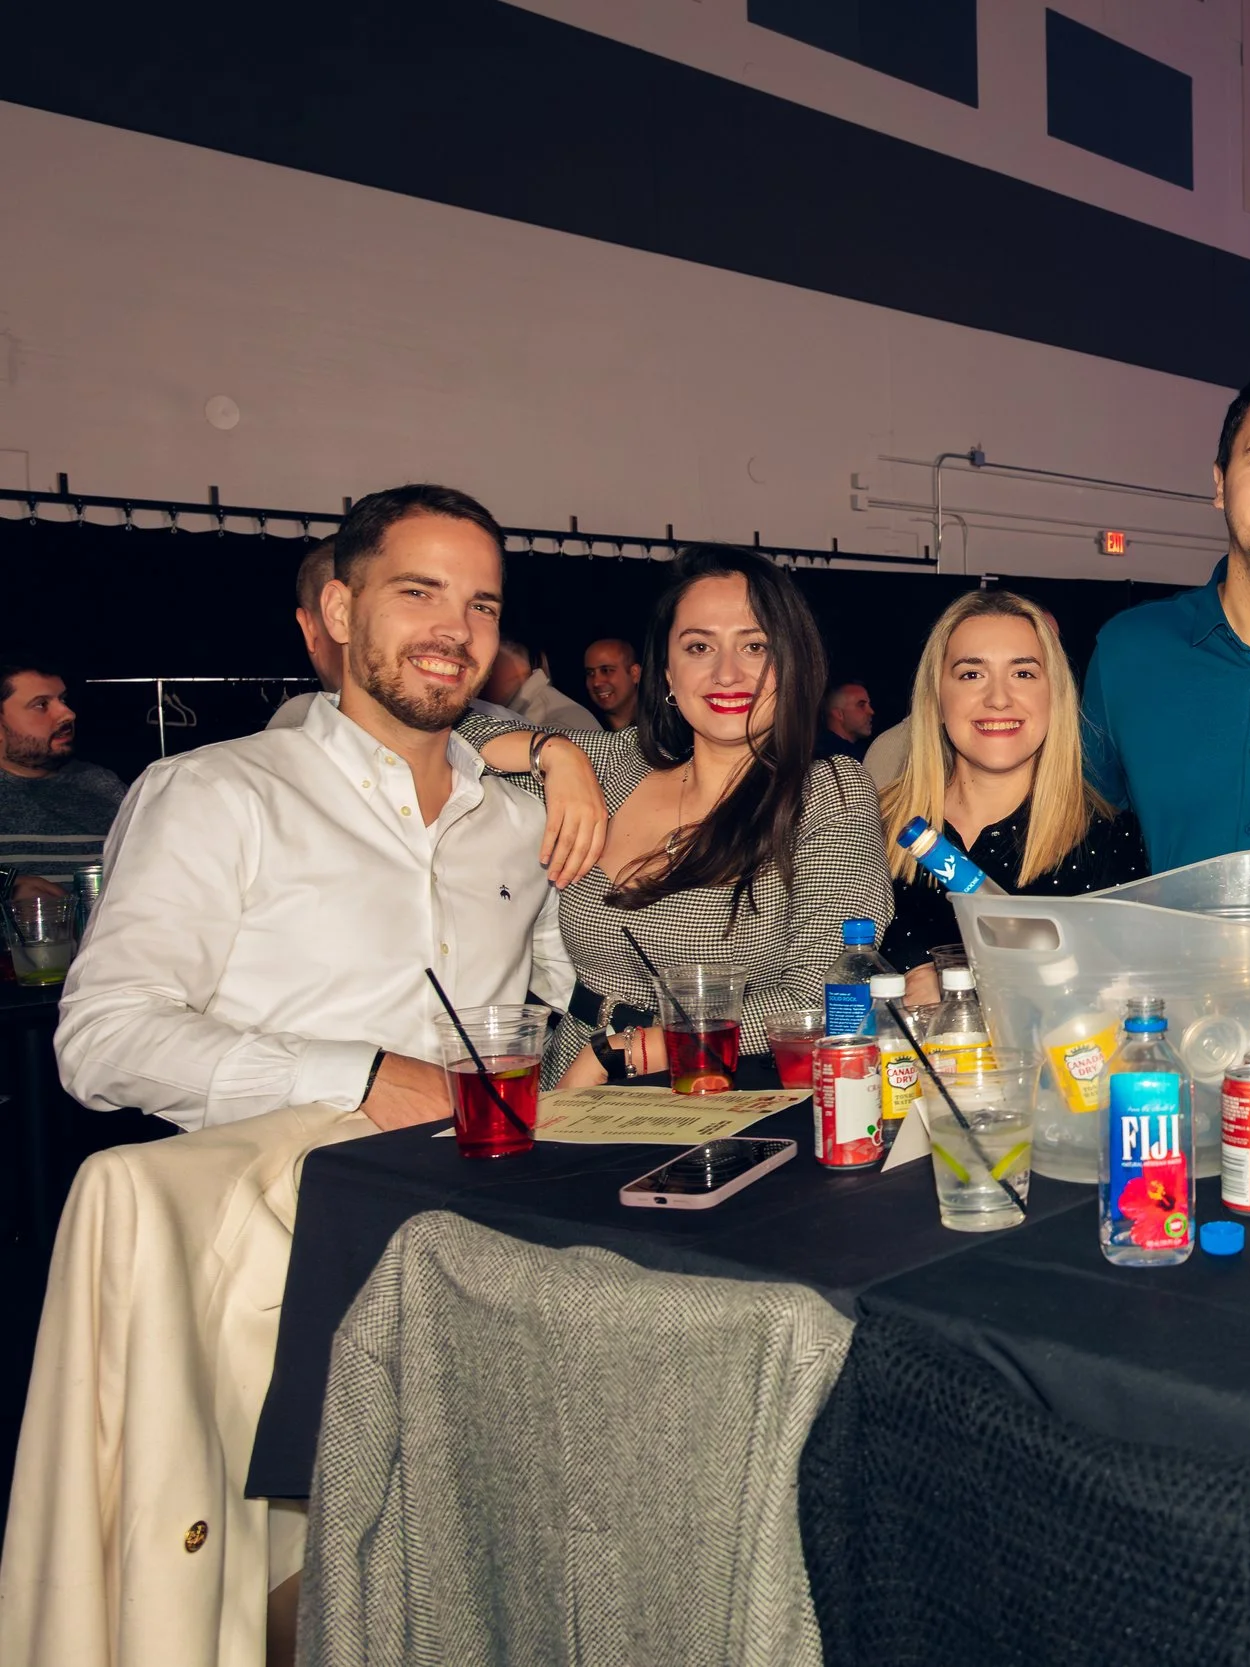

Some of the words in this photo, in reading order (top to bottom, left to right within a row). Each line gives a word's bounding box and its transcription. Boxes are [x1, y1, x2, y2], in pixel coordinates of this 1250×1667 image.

[1078, 1065, 1098, 1076] DRY
[896, 1074, 913, 1084] DRY
[1121, 1113, 1181, 1161] FIJI
